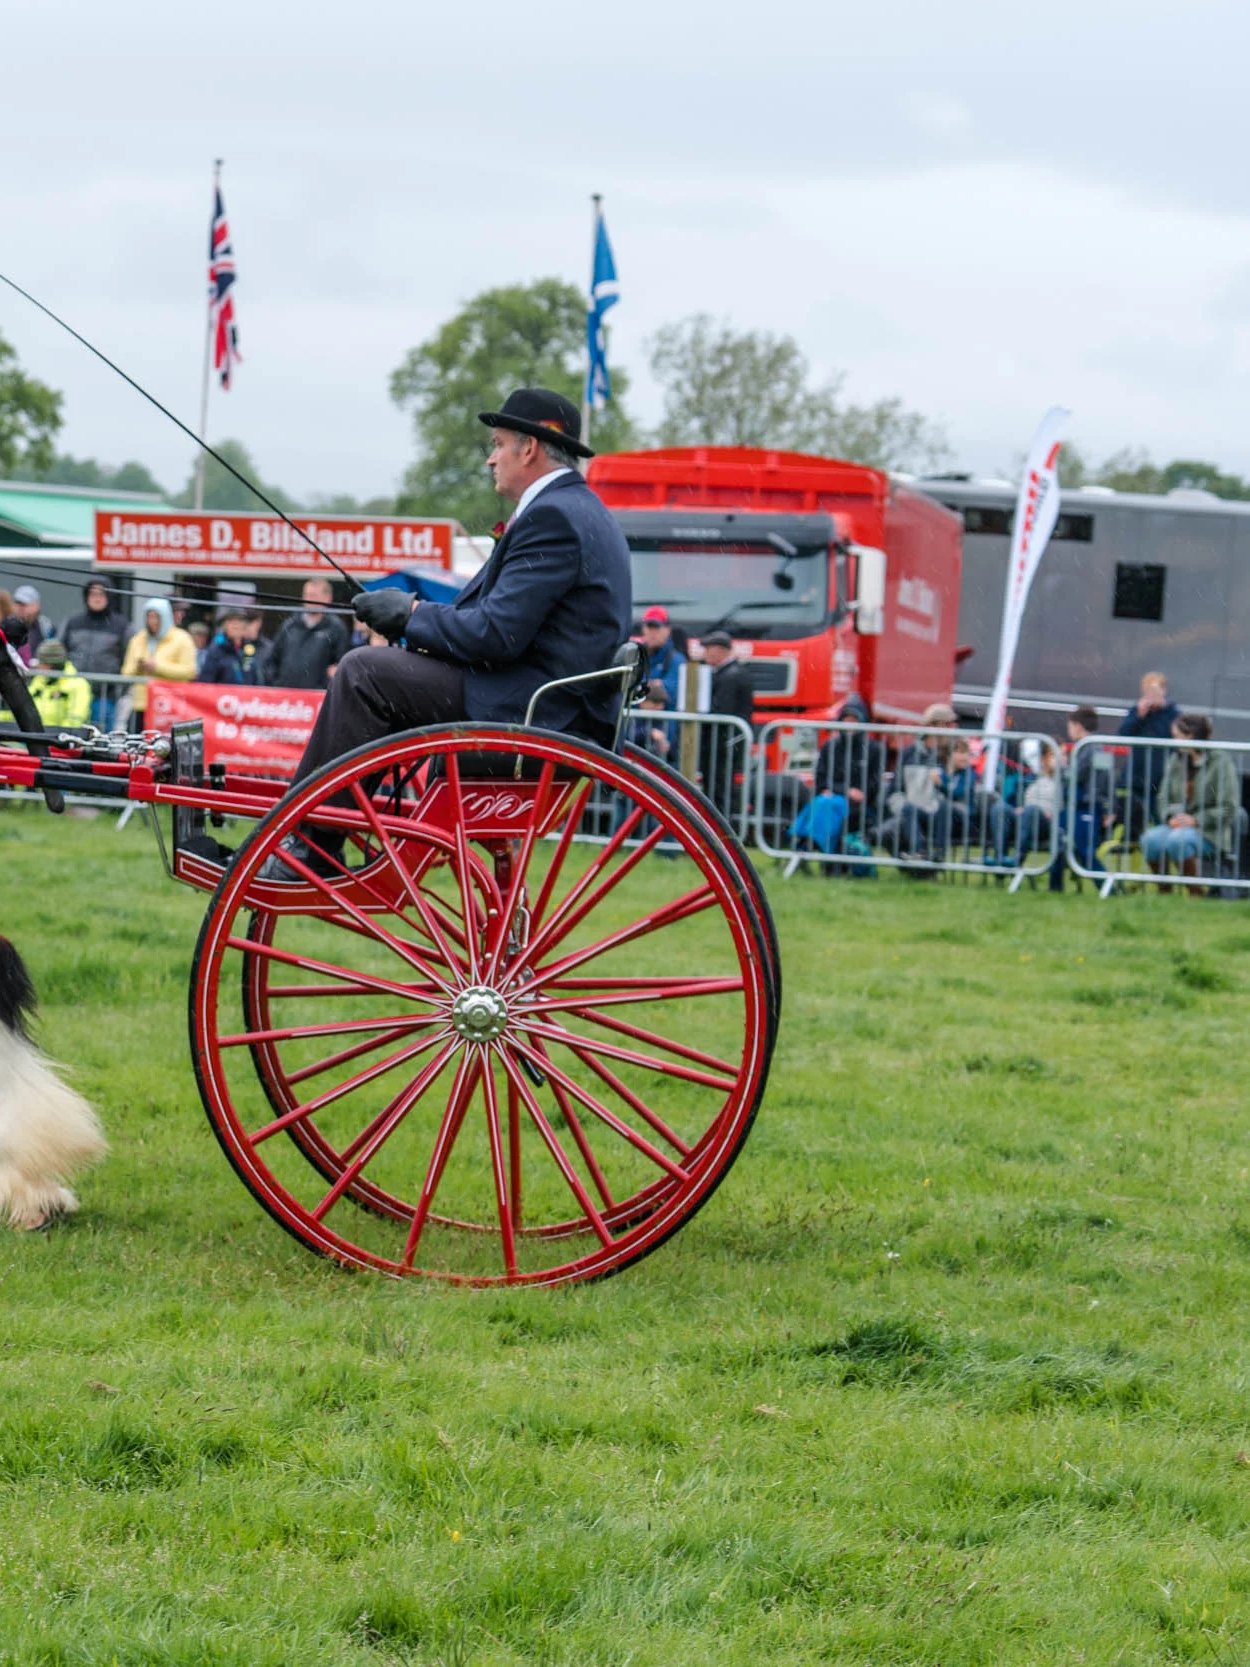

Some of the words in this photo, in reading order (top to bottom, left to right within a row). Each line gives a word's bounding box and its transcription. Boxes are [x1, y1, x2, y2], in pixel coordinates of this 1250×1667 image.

[102, 516, 202, 548] James
[210, 519, 241, 549] D.
[251, 520, 374, 554] Bilsland
[382, 525, 443, 557] Ltd.
[217, 695, 313, 721] Clydesdale
[216, 721, 238, 738] to
